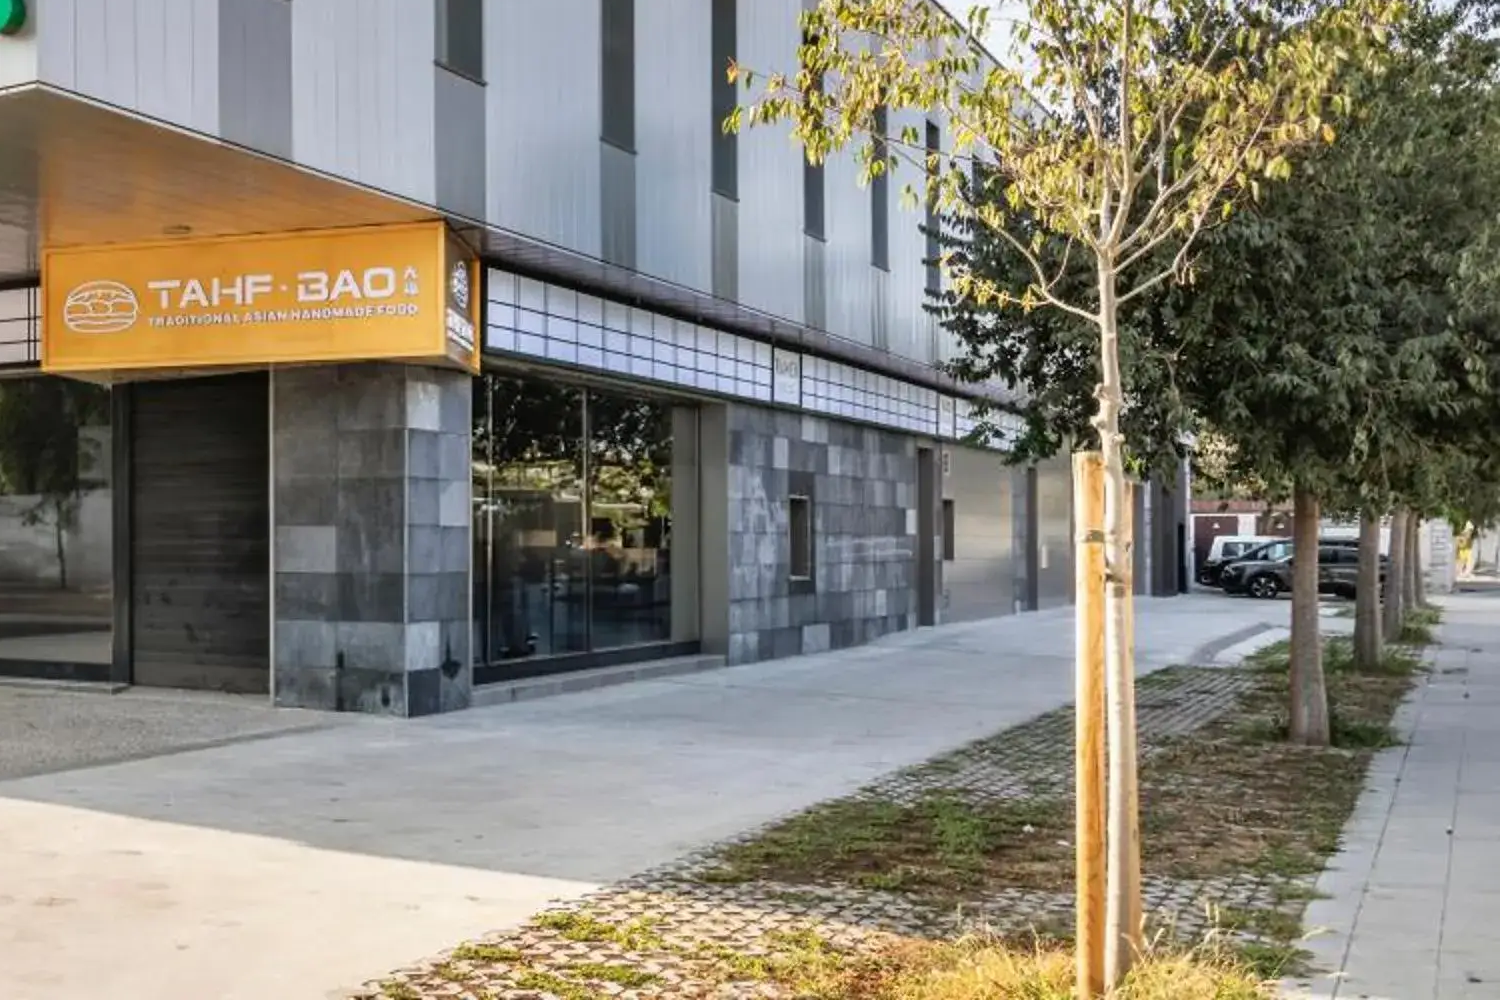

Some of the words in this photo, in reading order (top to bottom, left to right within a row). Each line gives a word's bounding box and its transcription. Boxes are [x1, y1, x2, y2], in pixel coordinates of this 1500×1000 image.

[147, 273, 274, 310] TAHF
[297, 266, 396, 303] BAO
[148, 311, 240, 329] TRADITIONAL
[243, 309, 288, 325] ASIAN
[290, 303, 375, 321] HANDMADE
[377, 302, 419, 317] FOOD
